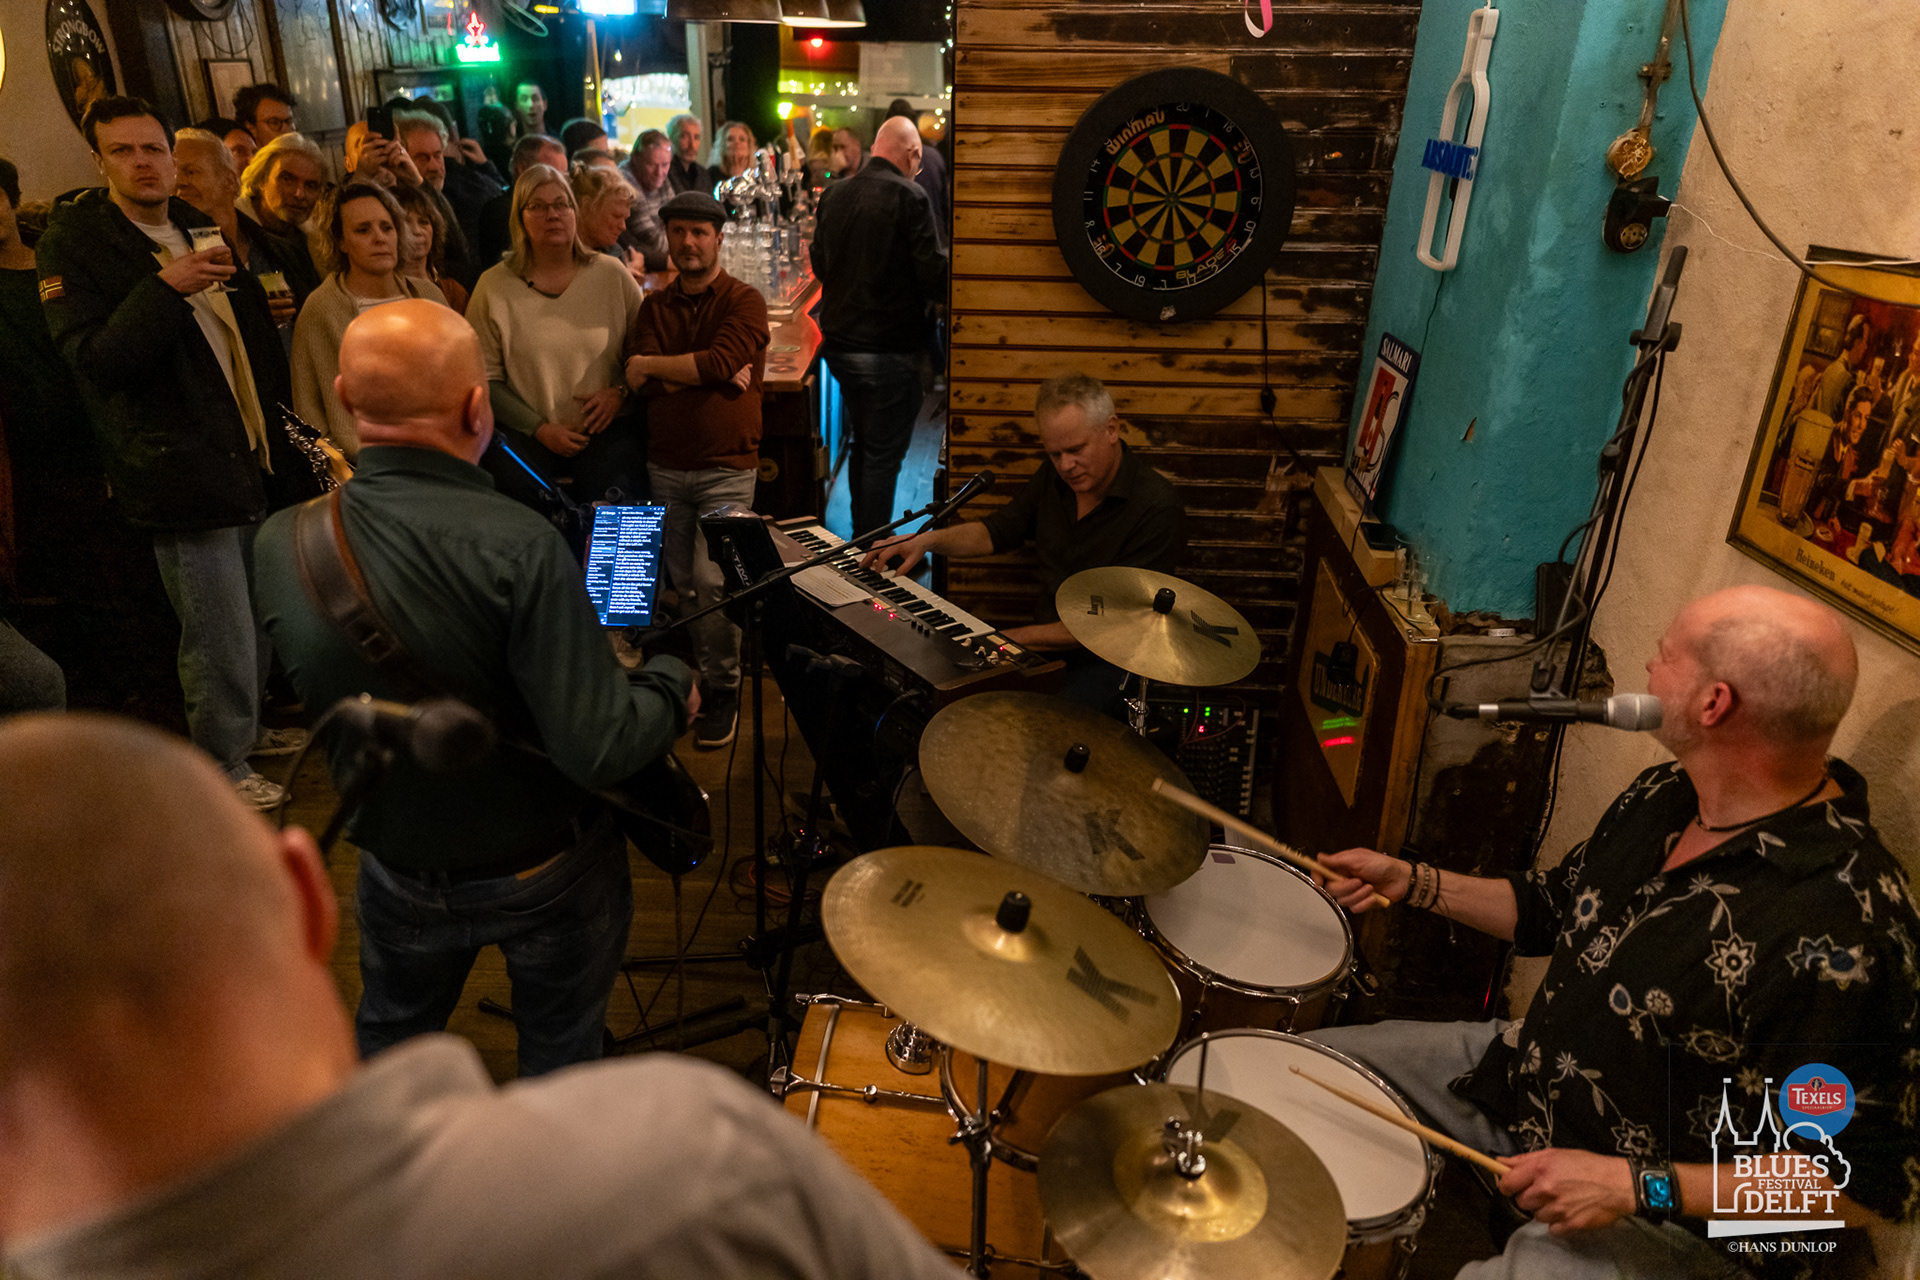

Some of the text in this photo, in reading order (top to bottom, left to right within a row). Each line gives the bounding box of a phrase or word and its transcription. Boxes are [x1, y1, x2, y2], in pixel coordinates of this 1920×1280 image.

[53, 19, 105, 55] STRONGBOW
[1243, 220, 1257, 232] 10
[1175, 247, 1225, 280] BLADE
[1230, 243, 1242, 256] 15
[1133, 274, 1147, 287] 19
[1381, 337, 1413, 374] SALMARI
[1796, 547, 1835, 582] Heineken
[1191, 610, 1239, 648] K
[1084, 808, 1146, 861] K
[1066, 946, 1159, 1025] K
